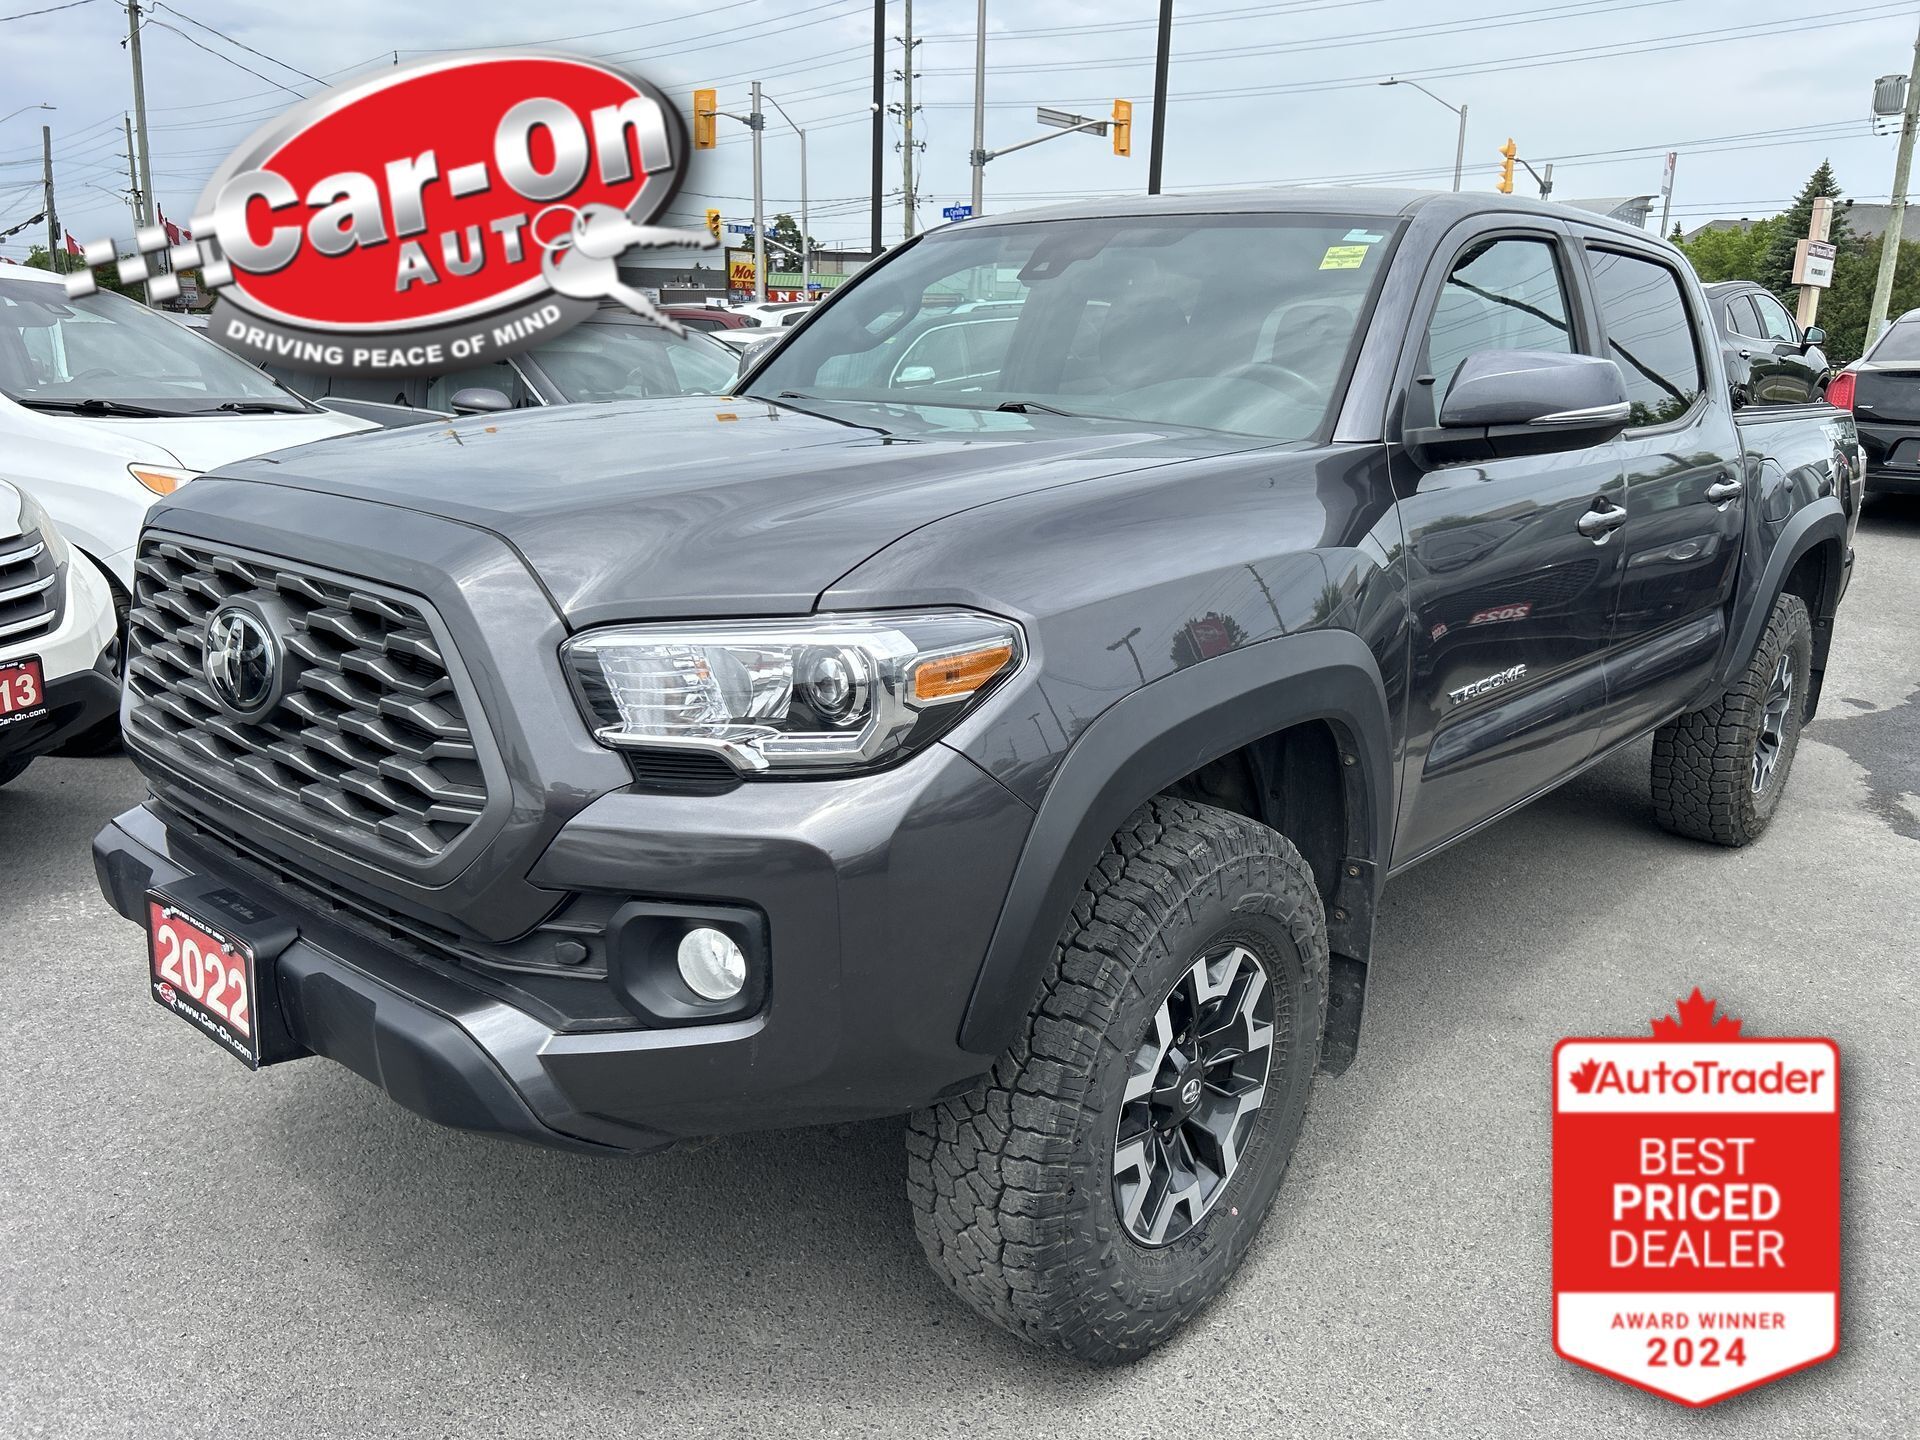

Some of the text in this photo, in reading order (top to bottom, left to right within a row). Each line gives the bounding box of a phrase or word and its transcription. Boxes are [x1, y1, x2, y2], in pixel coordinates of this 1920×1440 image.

[1448, 664, 1527, 704] TACOMA
[158, 925, 250, 1038] 2022
[177, 999, 253, 1061] www.Car-On.com
